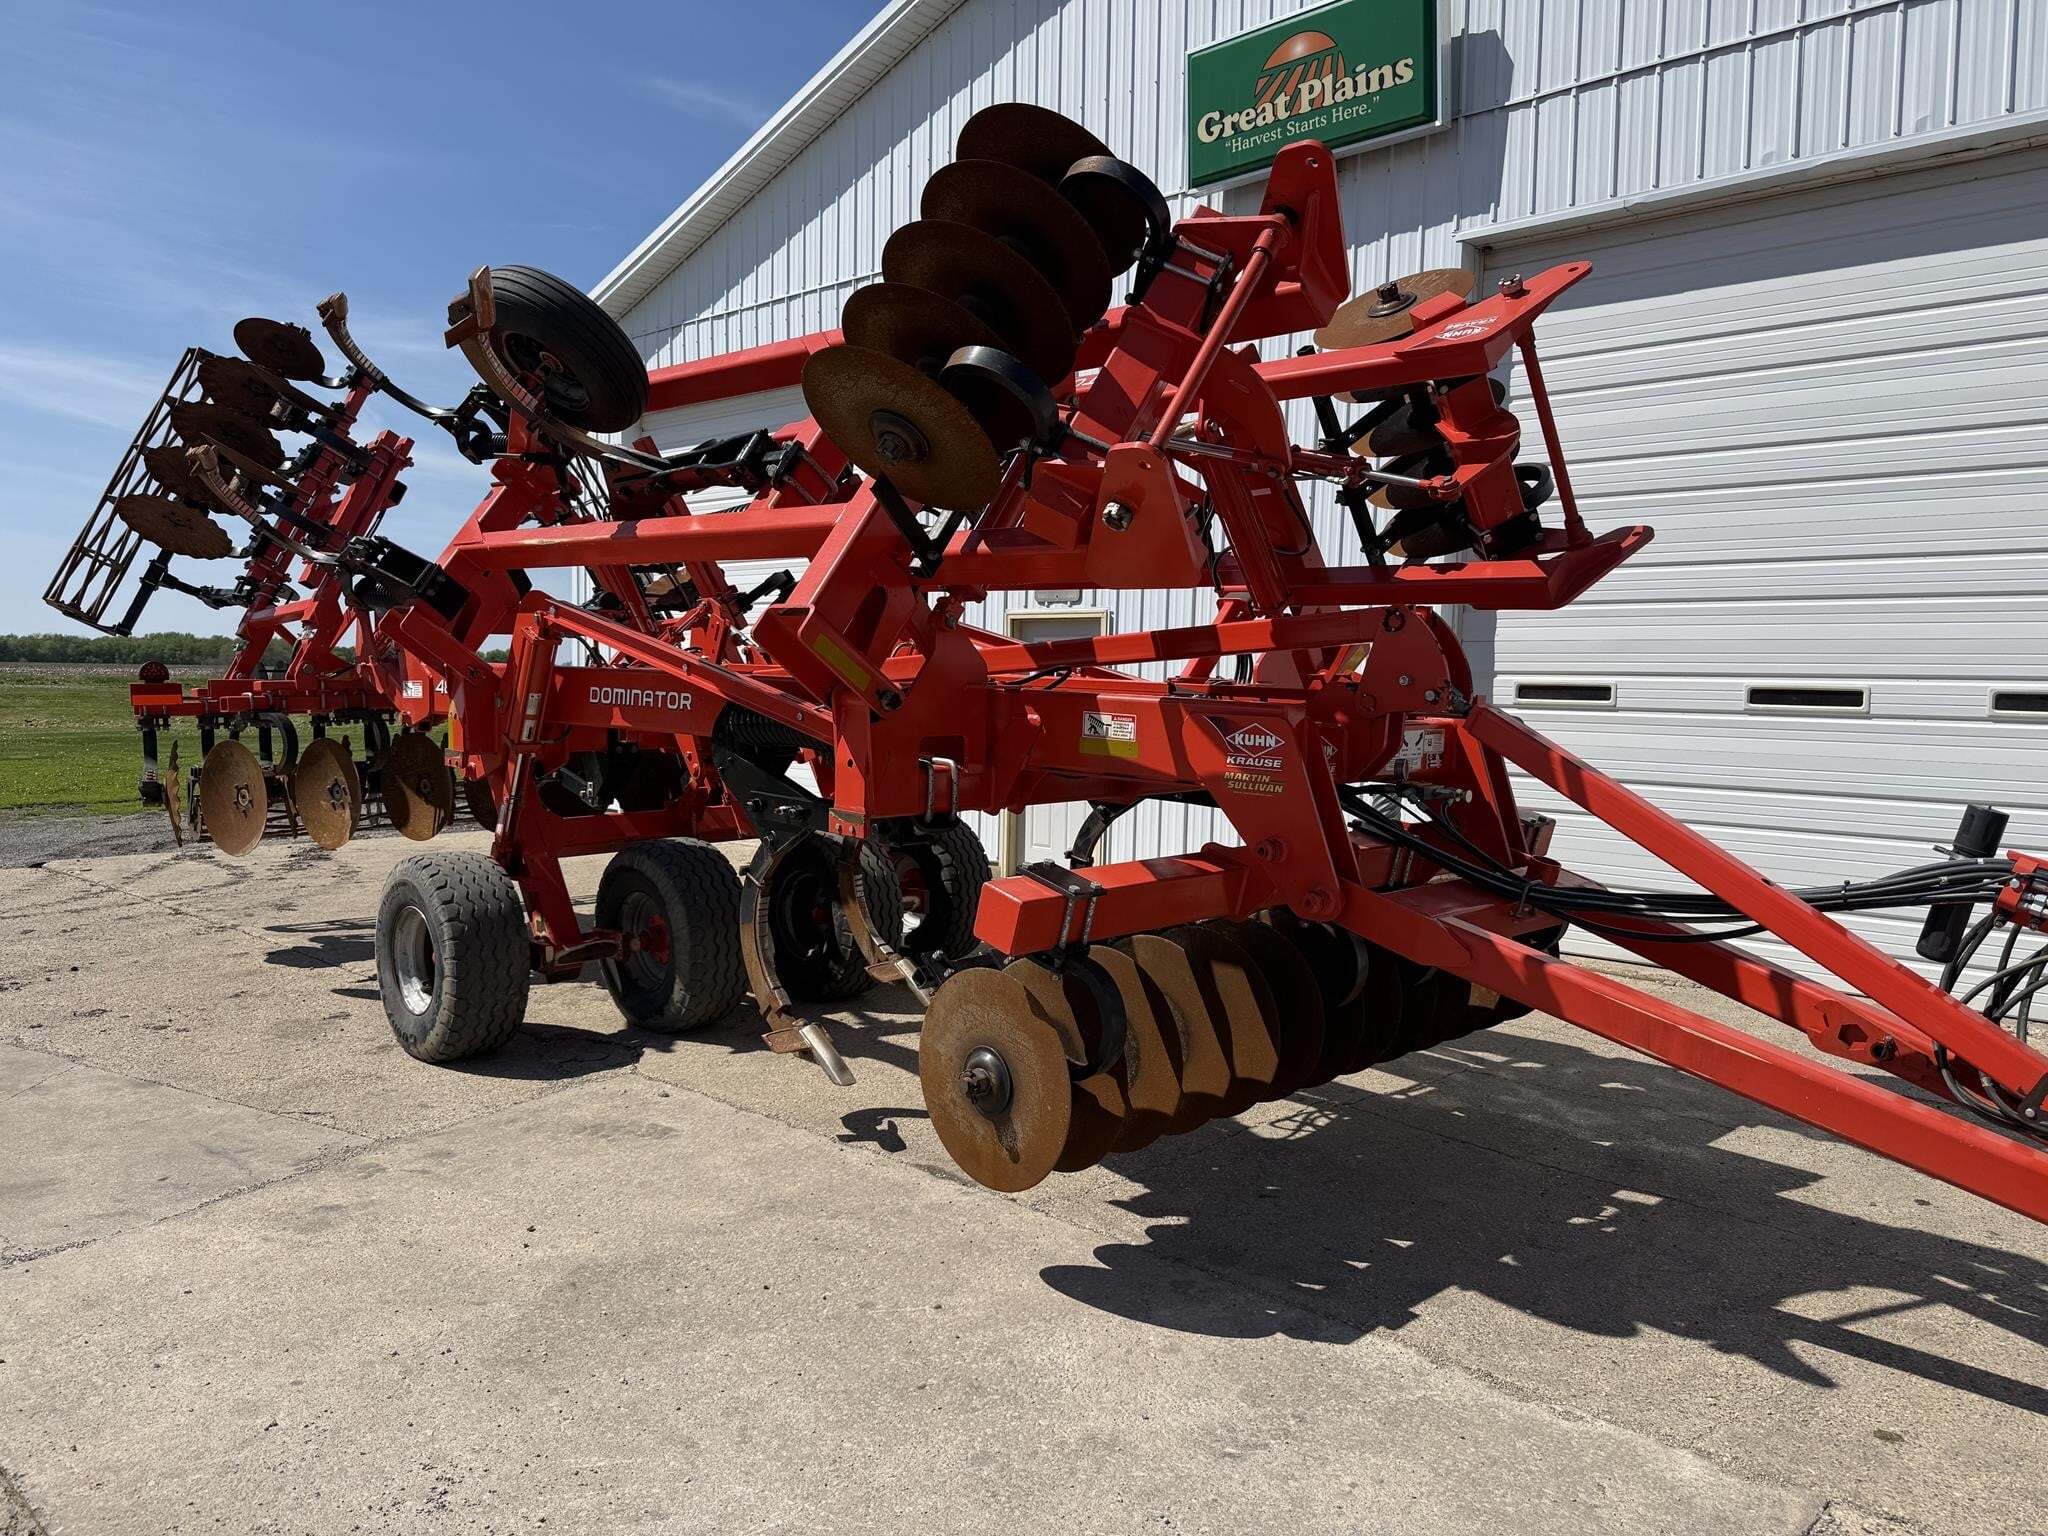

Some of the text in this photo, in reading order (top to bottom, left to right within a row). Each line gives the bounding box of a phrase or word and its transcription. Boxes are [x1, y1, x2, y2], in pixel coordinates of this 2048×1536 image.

[1197, 57, 1414, 143] Great Plains
[1286, 115, 1327, 136] Starts
[589, 686, 692, 710] DOMINATOR
[1234, 733, 1276, 747] KUHN
[1226, 755, 1282, 768] KRAUSE
[1224, 771, 1271, 782] MARTIN
[1227, 781, 1284, 793] SULLIVAN
